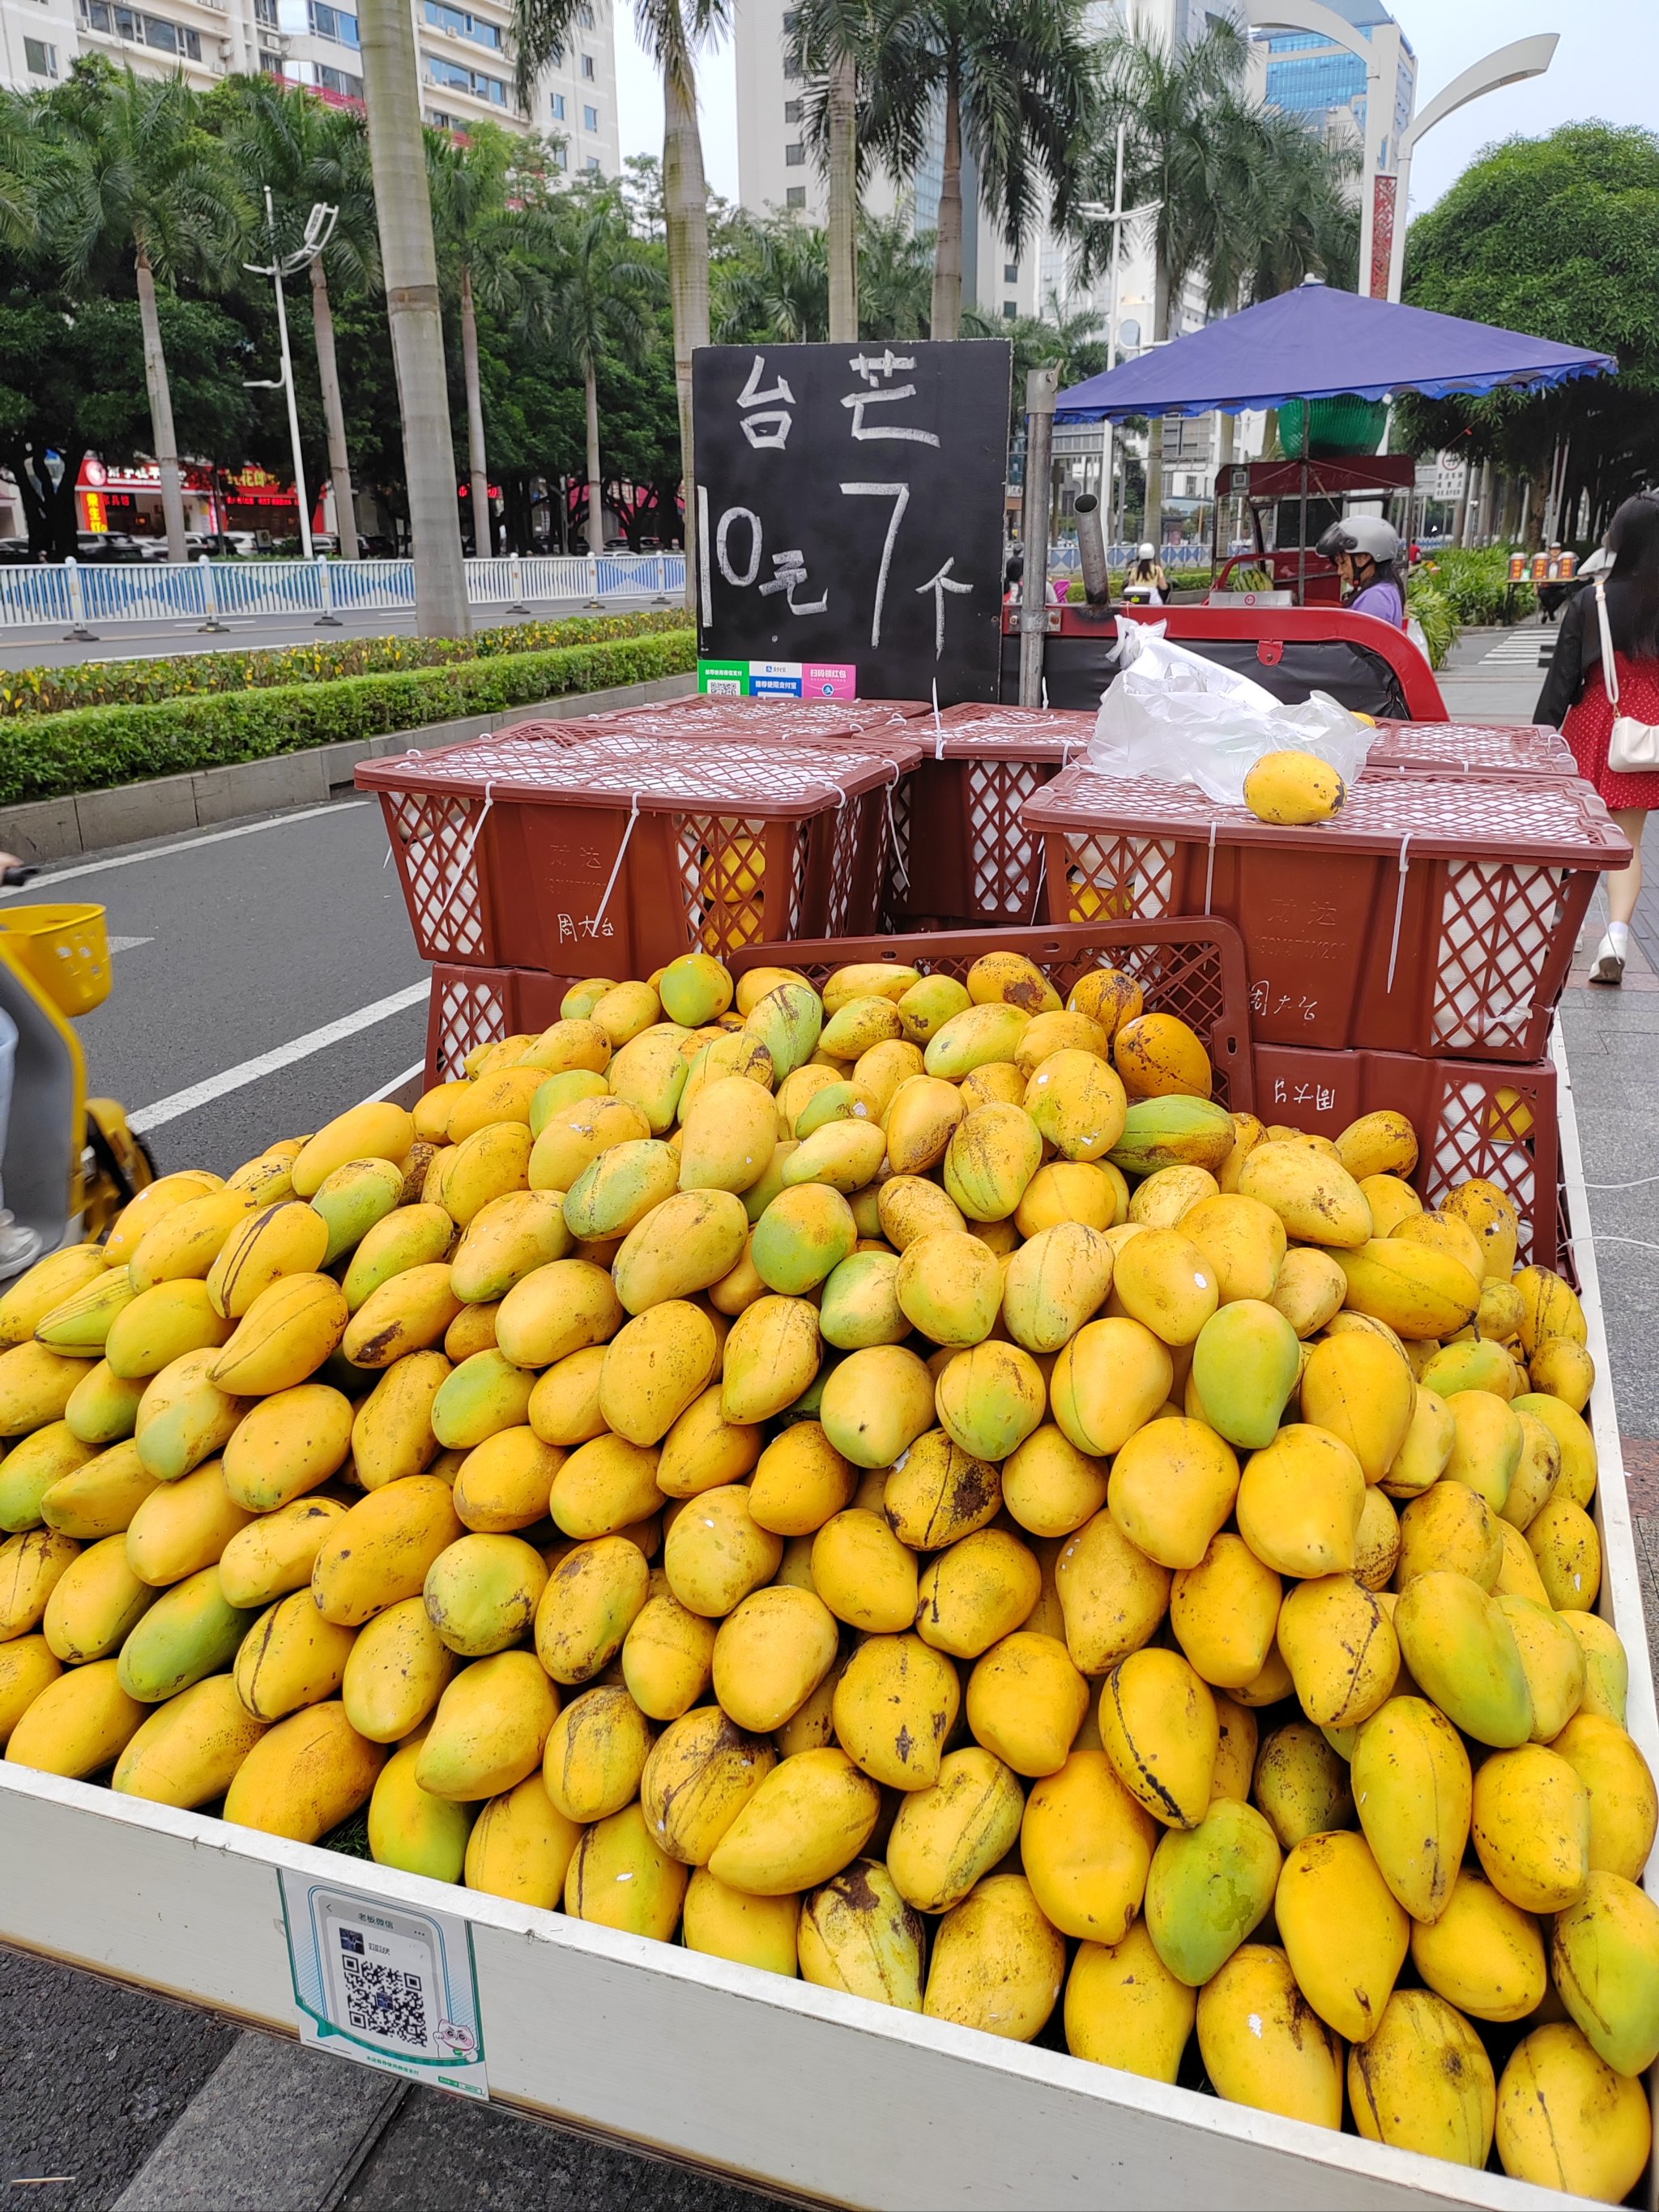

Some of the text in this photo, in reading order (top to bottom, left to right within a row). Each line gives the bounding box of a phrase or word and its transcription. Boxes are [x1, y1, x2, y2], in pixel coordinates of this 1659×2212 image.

[809, 668, 847, 679] 扫码领红包
[358, 1912, 394, 1929] 老板微信
